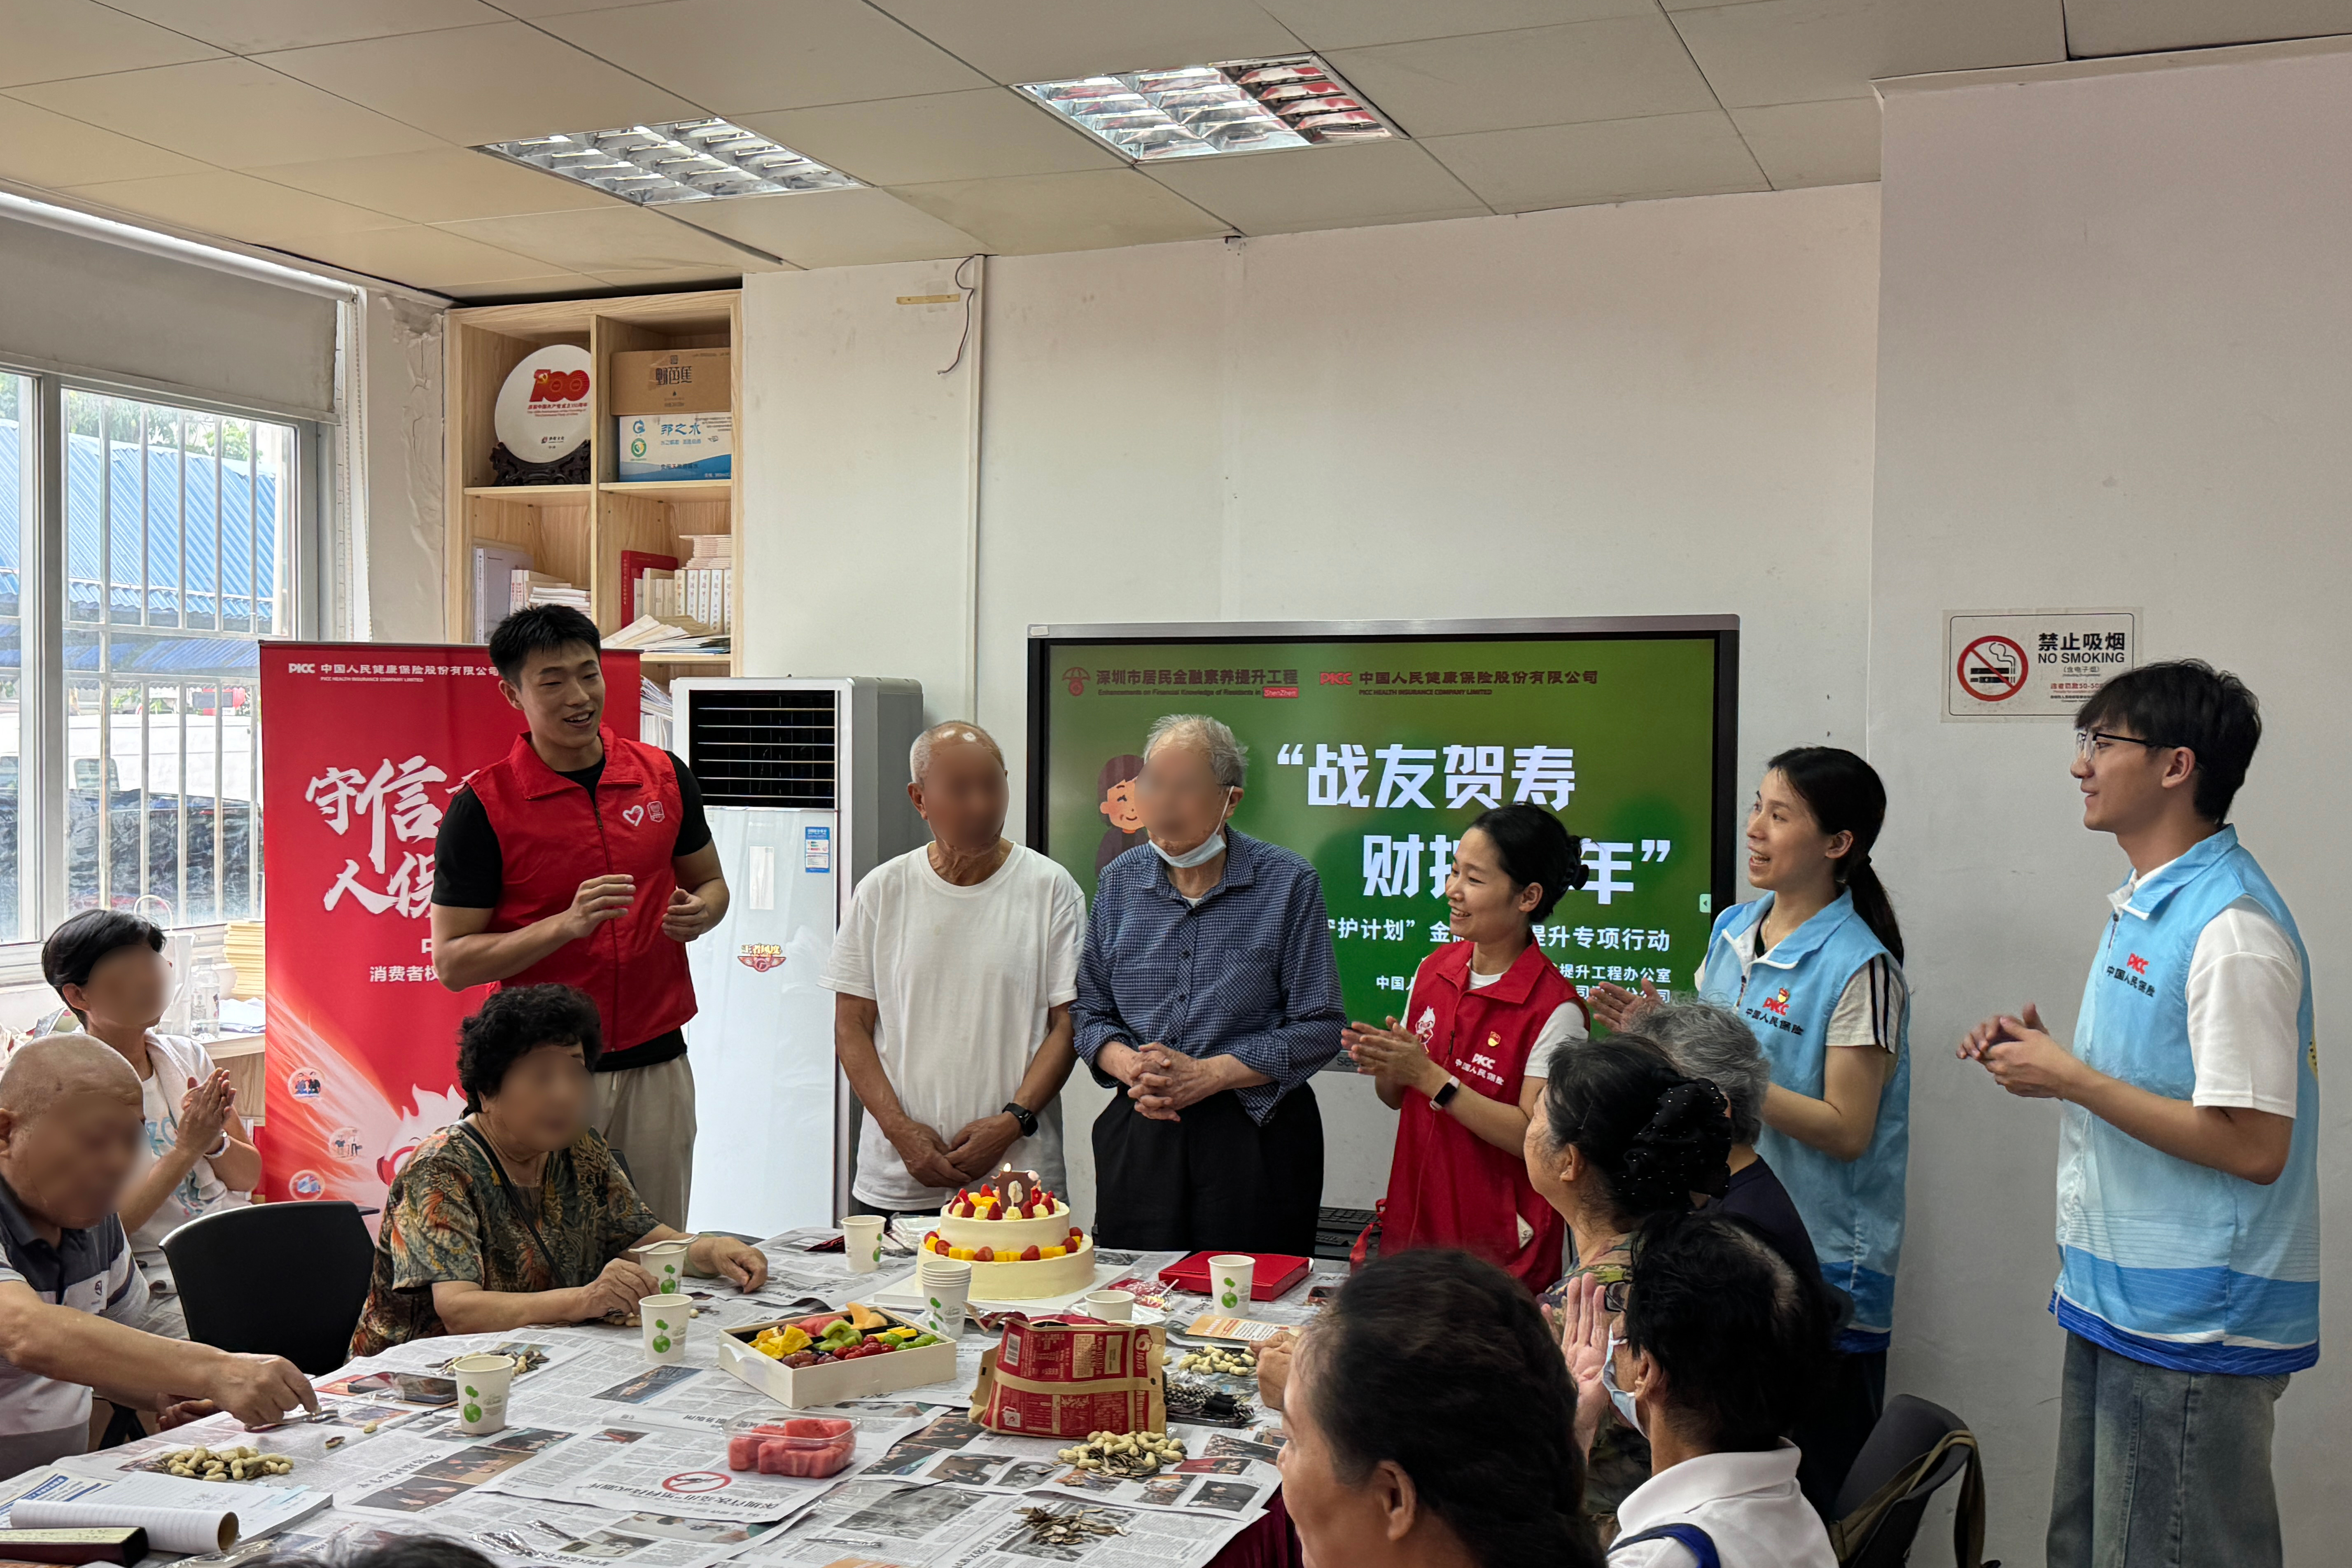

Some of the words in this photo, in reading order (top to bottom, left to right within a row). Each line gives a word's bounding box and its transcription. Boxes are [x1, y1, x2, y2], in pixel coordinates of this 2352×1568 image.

[530, 369, 590, 402] 100
[2038, 632, 2125, 651] 禁止吸烟
[2038, 653, 2057, 663] NO
[2061, 652, 2125, 663] SMOKING
[289, 663, 315, 674] PICC
[321, 664, 499, 676] 中国人民健康保险股份有限公司
[1096, 669, 1298, 685] 深圳市居民金融素养提升工程
[1359, 671, 1598, 684] 中国人民健康保险股份有限公司
[1320, 672, 1353, 685] PICC
[305, 755, 480, 874] 守信
[1553, 963, 1671, 983] 提升工程办公室
[2127, 953, 2149, 975] PICC
[2107, 965, 2155, 997] 中国人民保险
[1762, 997, 1790, 1016] PICC
[1746, 1008, 1804, 1035] 中国人民保险
[1472, 1053, 1496, 1070] PICC
